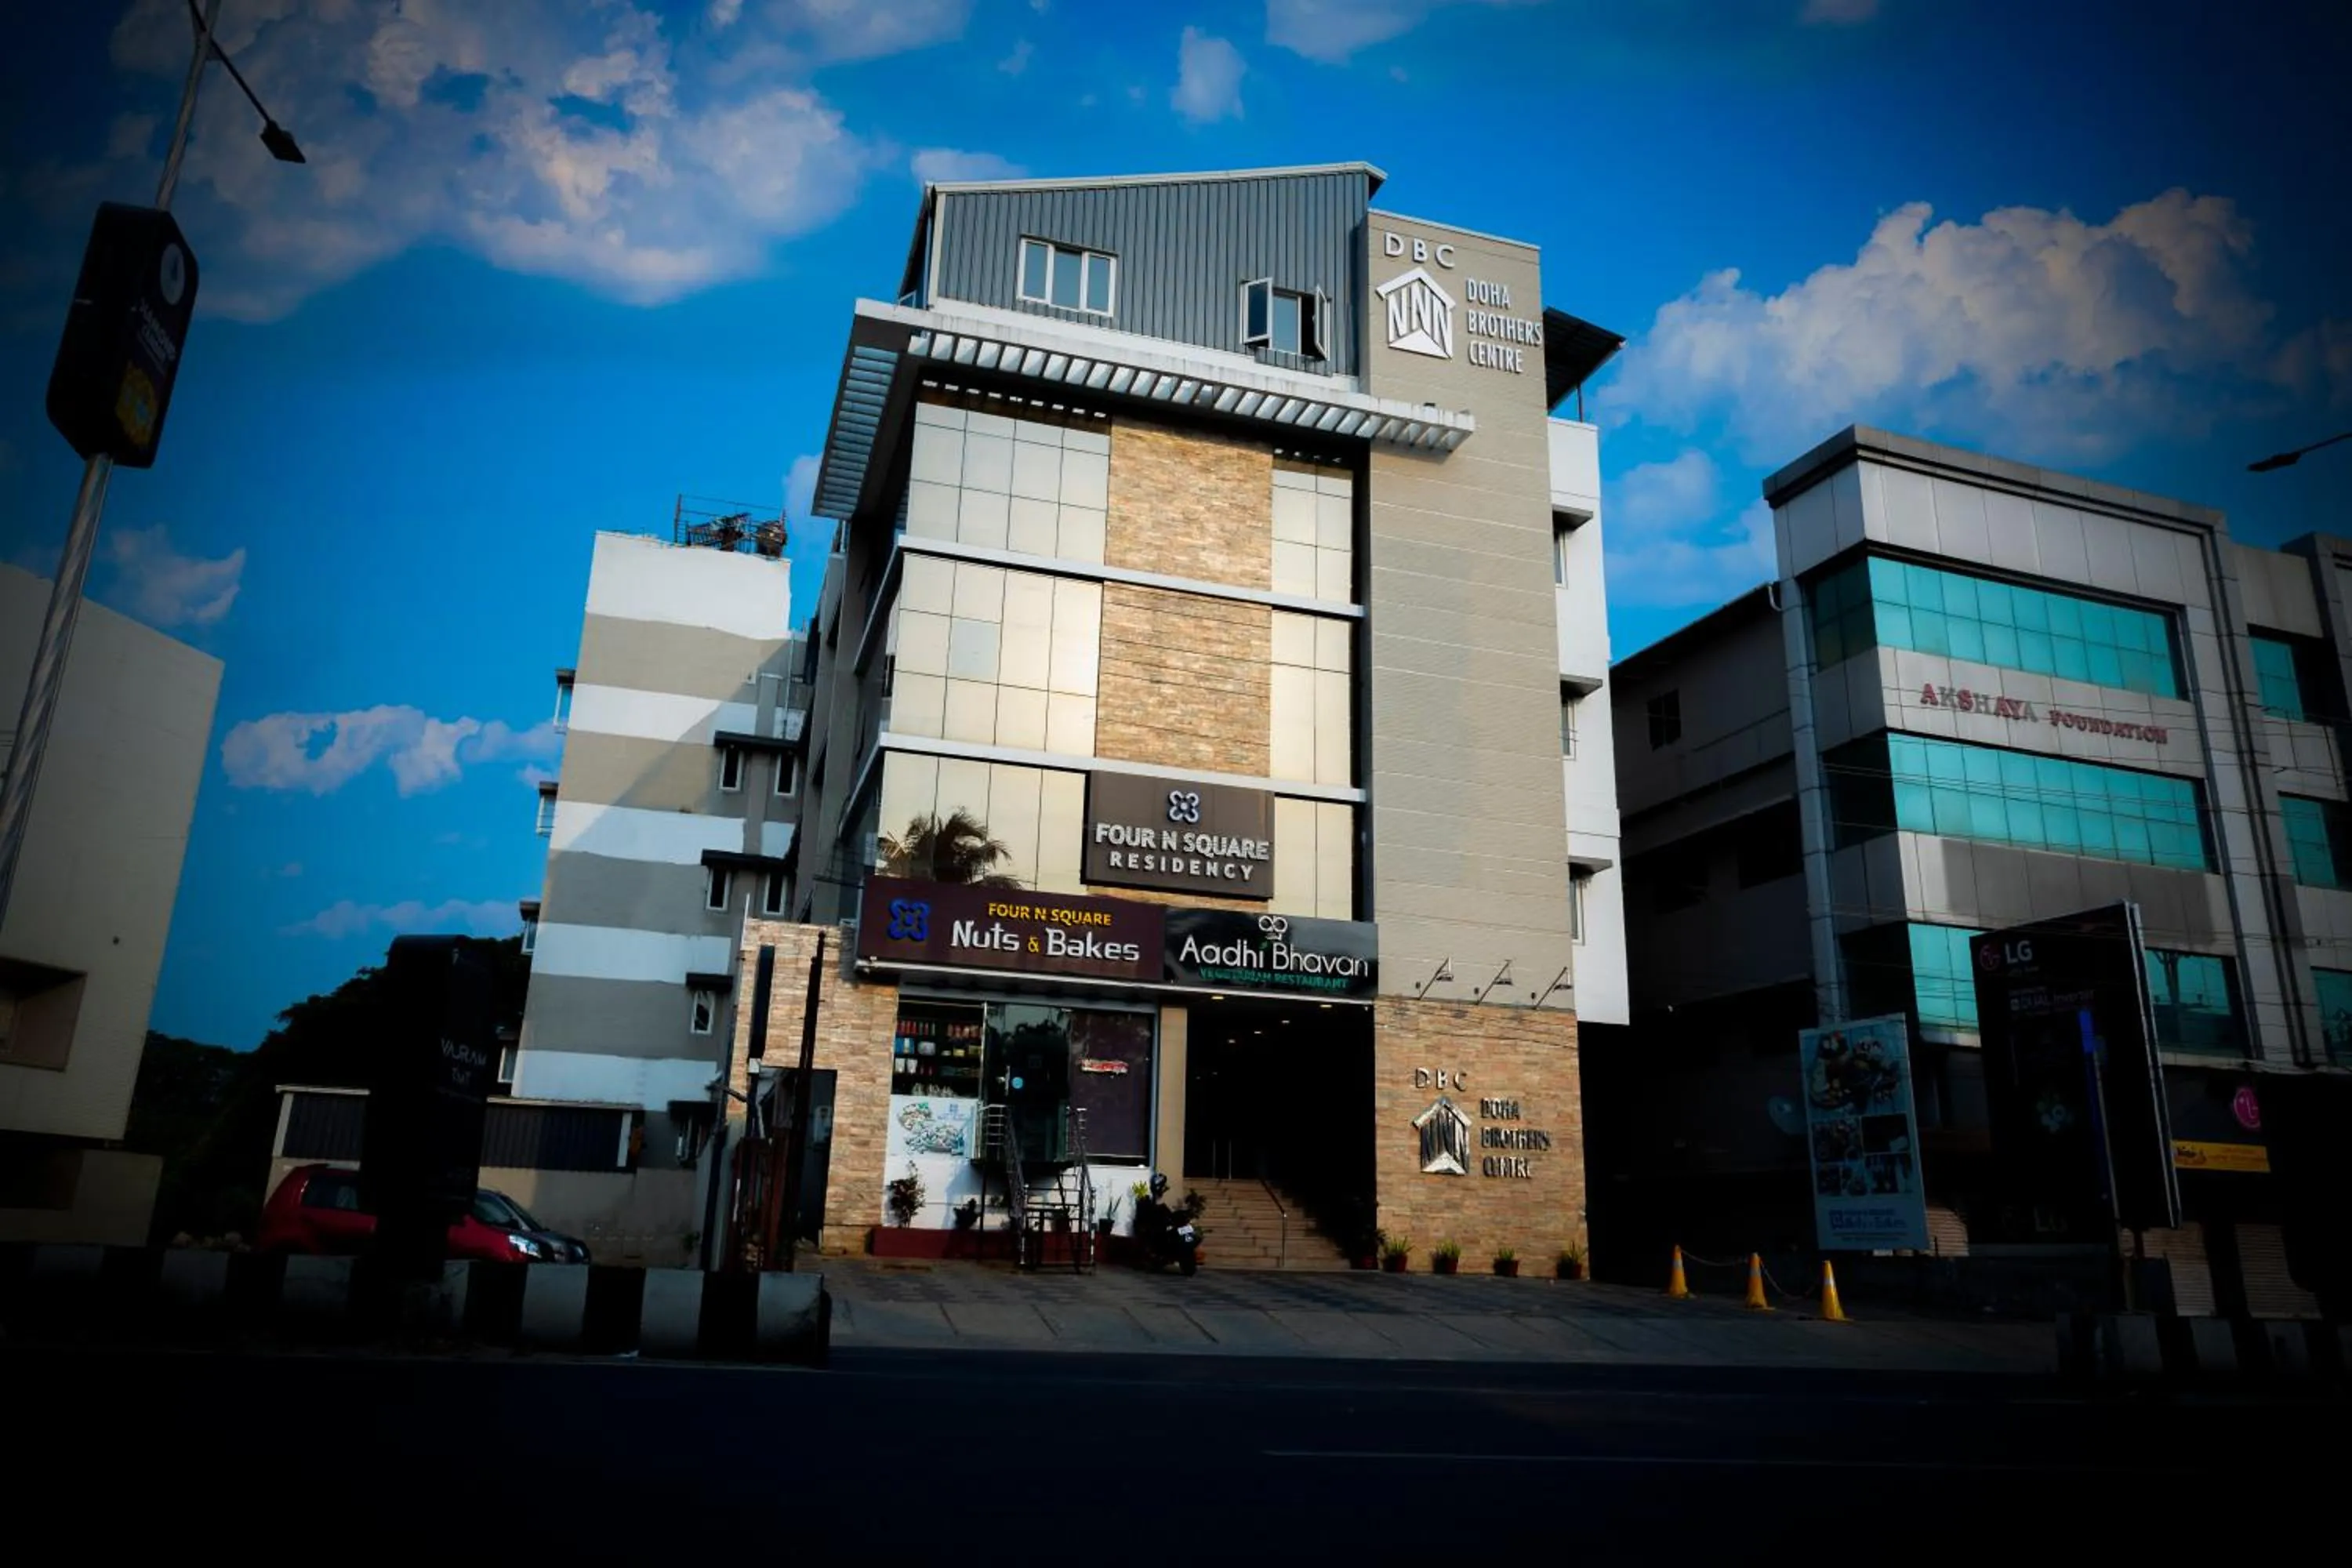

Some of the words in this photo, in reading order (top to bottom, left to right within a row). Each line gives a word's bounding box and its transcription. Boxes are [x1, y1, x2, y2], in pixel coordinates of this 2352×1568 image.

[1385, 232, 1455, 270] DBC
[1467, 278, 1512, 310] DOHA
[1468, 310, 1543, 346] BROTHERS
[1469, 340, 1523, 373] CENTRE
[1921, 683, 2038, 723] AKSHAYA
[2049, 709, 2169, 745] FOUNDATION
[1095, 822, 1156, 851] FOUR
[1161, 829, 1178, 851] N
[1183, 831, 1270, 862] SQUARE
[1109, 851, 1254, 881] RESIDENCY
[988, 902, 1032, 920] FOUR
[1034, 906, 1048, 922] N
[1050, 908, 1112, 927] SQUARE
[951, 920, 1020, 953] Nuts
[1027, 935, 1040, 953] &
[1045, 928, 1141, 963] Bakes
[1178, 934, 1265, 968] Aadhi
[1272, 943, 1369, 978] Bhavan
[2004, 939, 2033, 964] LG
[1272, 971, 1349, 989] RESTAURANT
[1414, 1067, 1468, 1091] DBC
